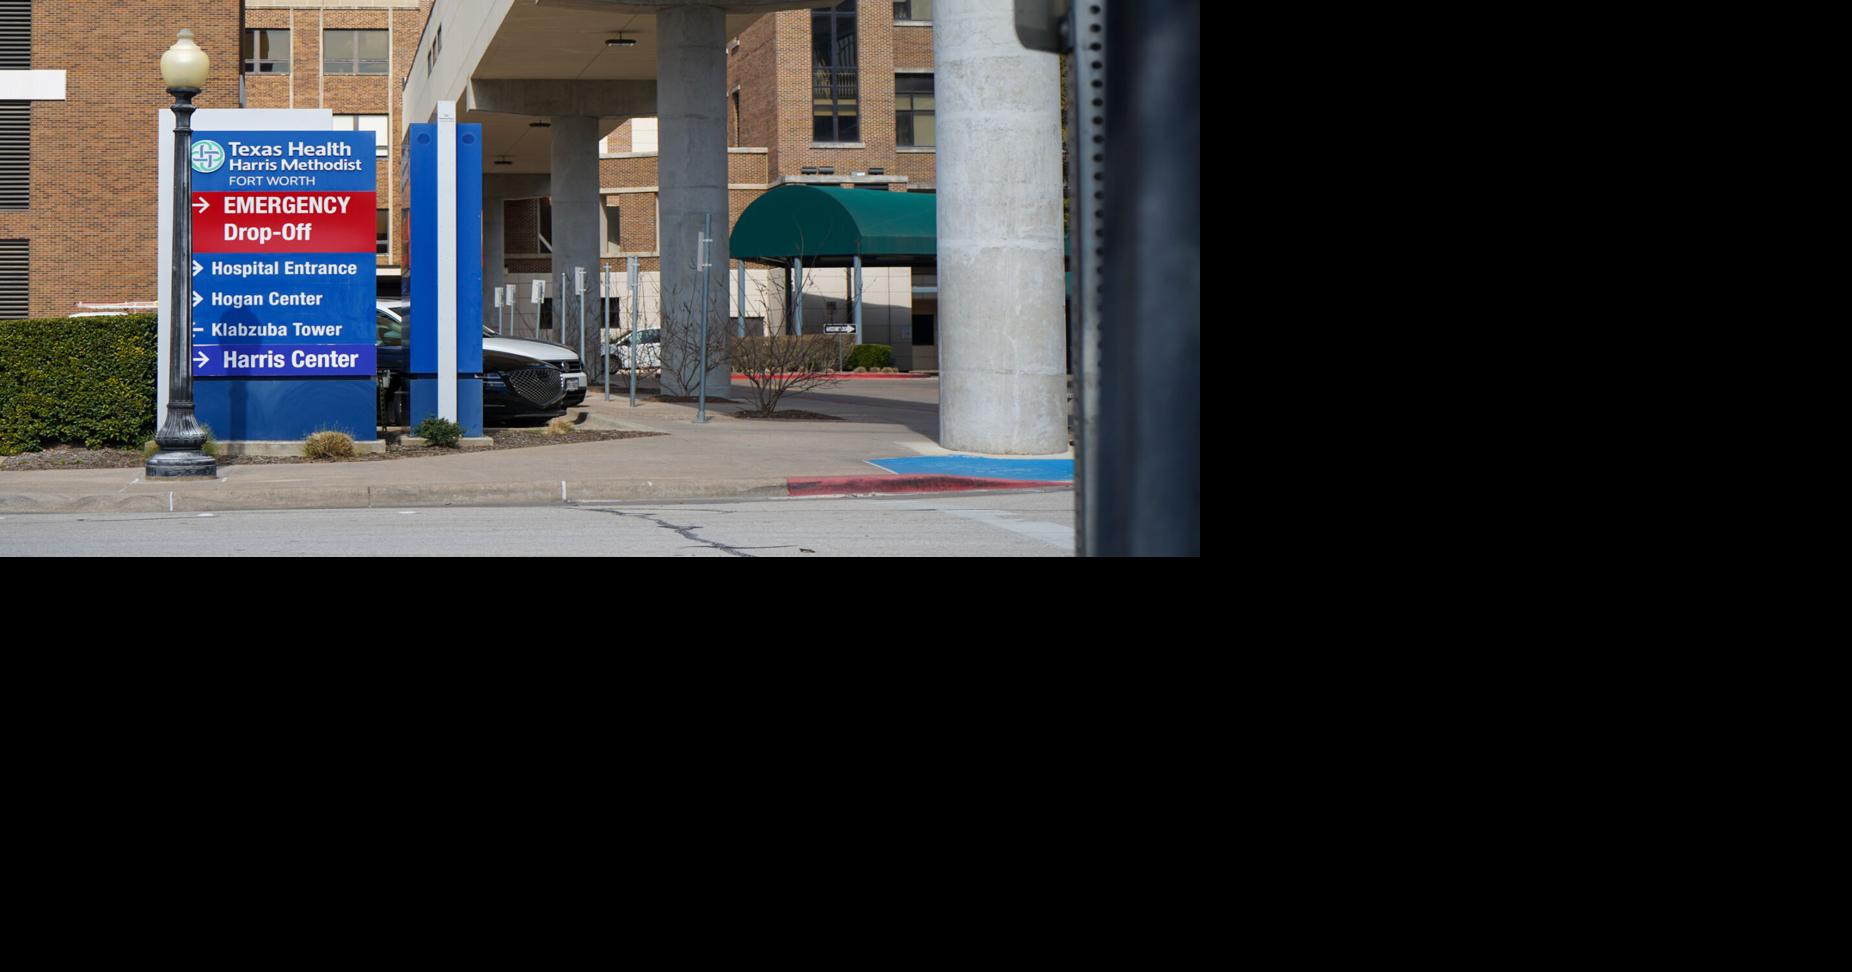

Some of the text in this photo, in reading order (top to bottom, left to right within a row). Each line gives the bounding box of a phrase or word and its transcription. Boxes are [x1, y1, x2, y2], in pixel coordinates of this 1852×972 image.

[228, 141, 352, 157] Texas Health
[229, 158, 362, 171] Harris Methodist
[229, 176, 316, 186] FORT WORTH
[223, 196, 351, 214] EMERGENCY
[223, 223, 312, 244] Drop-Off
[211, 261, 358, 278] Hospital Entrance
[211, 292, 323, 308] Hogan Center
[211, 323, 343, 337] Klabzuba Tower
[223, 350, 359, 368] Harris Center
